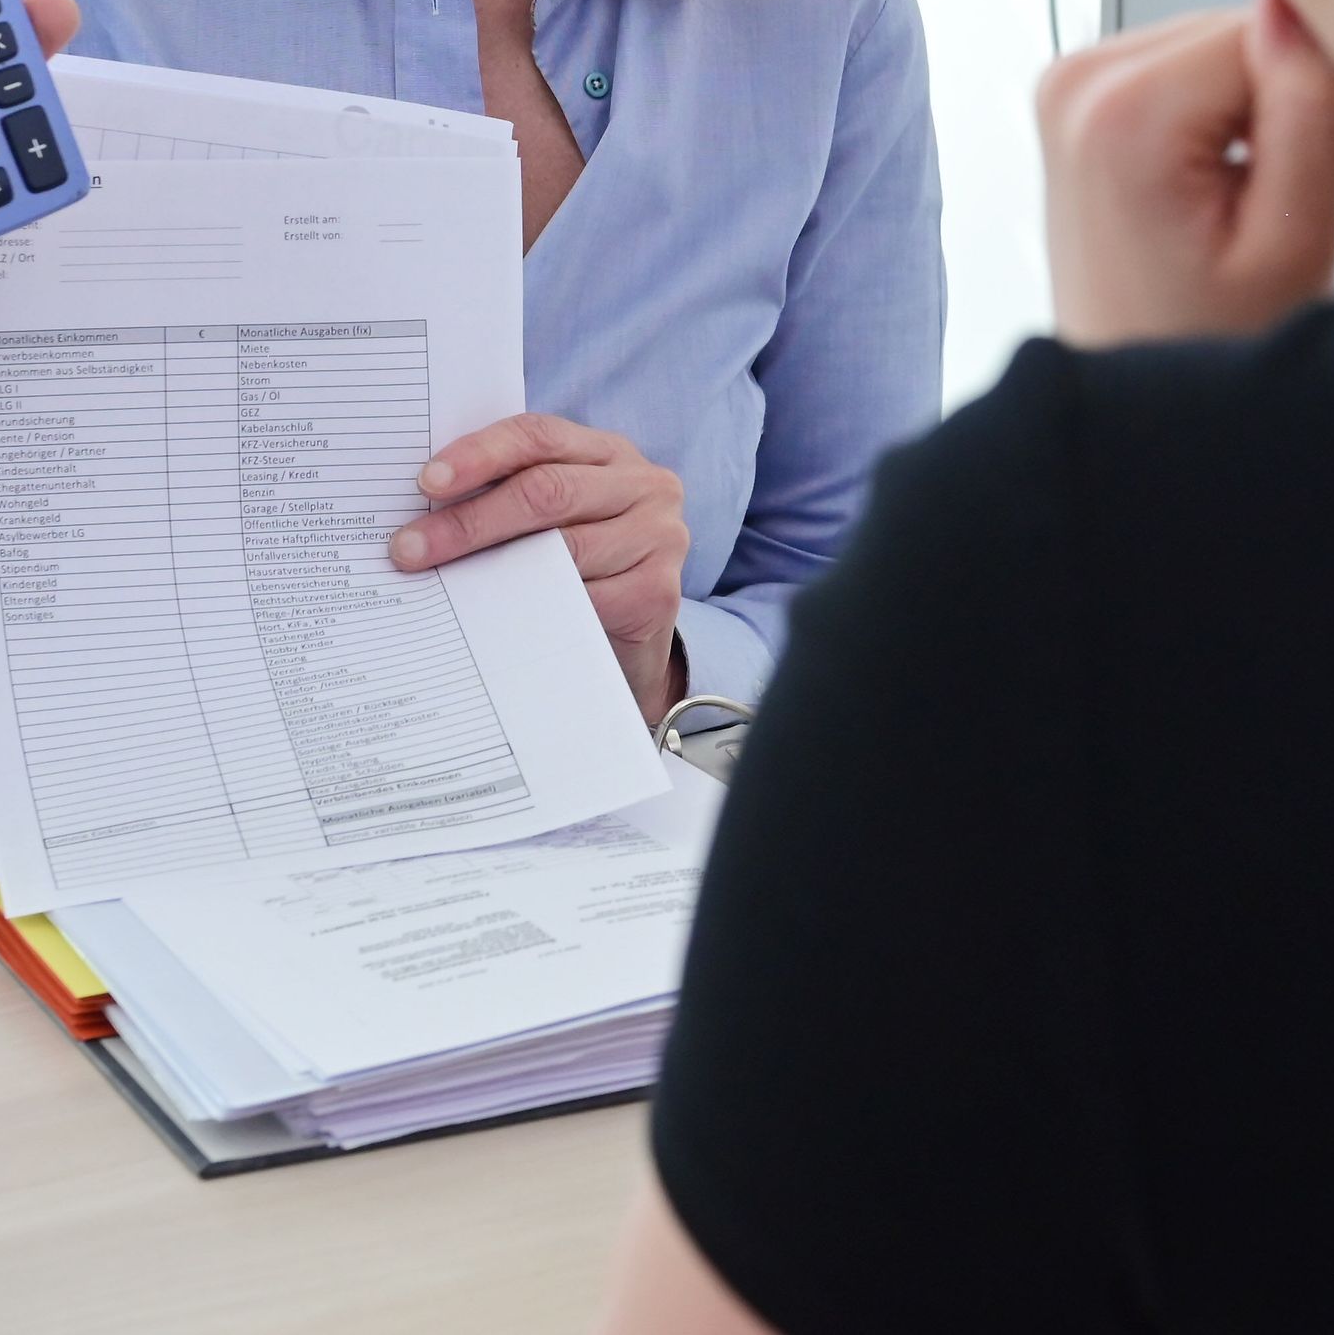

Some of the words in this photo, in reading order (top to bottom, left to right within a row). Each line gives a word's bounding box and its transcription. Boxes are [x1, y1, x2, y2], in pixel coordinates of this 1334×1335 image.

[284, 215, 319, 225] Erstellt
[322, 216, 341, 224] am:
[284, 231, 319, 241] Erstellt
[18, 253, 35, 263] Ort
[240, 327, 297, 337] Monatliche
[300, 326, 349, 338] Ausgaben
[352, 326, 372, 336] (fix)
[57, 333, 118, 343] Einkommen
[240, 344, 270, 354] Miete
[240, 360, 307, 369] Nebenkosten
[56, 367, 74, 375] aus
[240, 376, 271, 385] Strom
[240, 392, 259, 401] Gas
[240, 408, 260, 417] GEZ
[241, 422, 313, 433] Kabelanschluß
[34, 432, 75, 442] Pension
[241, 437, 329, 449] KFZ-Versicherung
[68, 446, 106, 456] Partner
[241, 455, 296, 465] KFZ-Steuer
[242, 471, 278, 482] Leasing
[289, 469, 319, 479] Kredit
[242, 488, 275, 497] Benzin
[243, 504, 278, 514] Garage
[288, 501, 334, 512] Stellplatz
[302, 515, 375, 527] Verkehrsmittel
[72, 529, 85, 538] LG
[245, 536, 279, 545] Private
[247, 549, 339, 561] Unfallversicherung
[1, 563, 60, 574] Stipendium
[248, 564, 351, 576] Hausratversicherung
[2, 579, 58, 590] Kindergeld
[251, 579, 350, 592] Lebensversicherung
[4, 595, 56, 606] Elterngeld
[253, 589, 379, 605] Rechtschutzversicherung
[5, 611, 54, 622] Sonstiges
[262, 629, 325, 644] Taschengeld
[265, 646, 298, 655] Hobby
[268, 655, 307, 666] Zeitung
[271, 666, 305, 676] Verein
[275, 668, 348, 686] Mitgliedschaft
[281, 696, 314, 707] Handy
